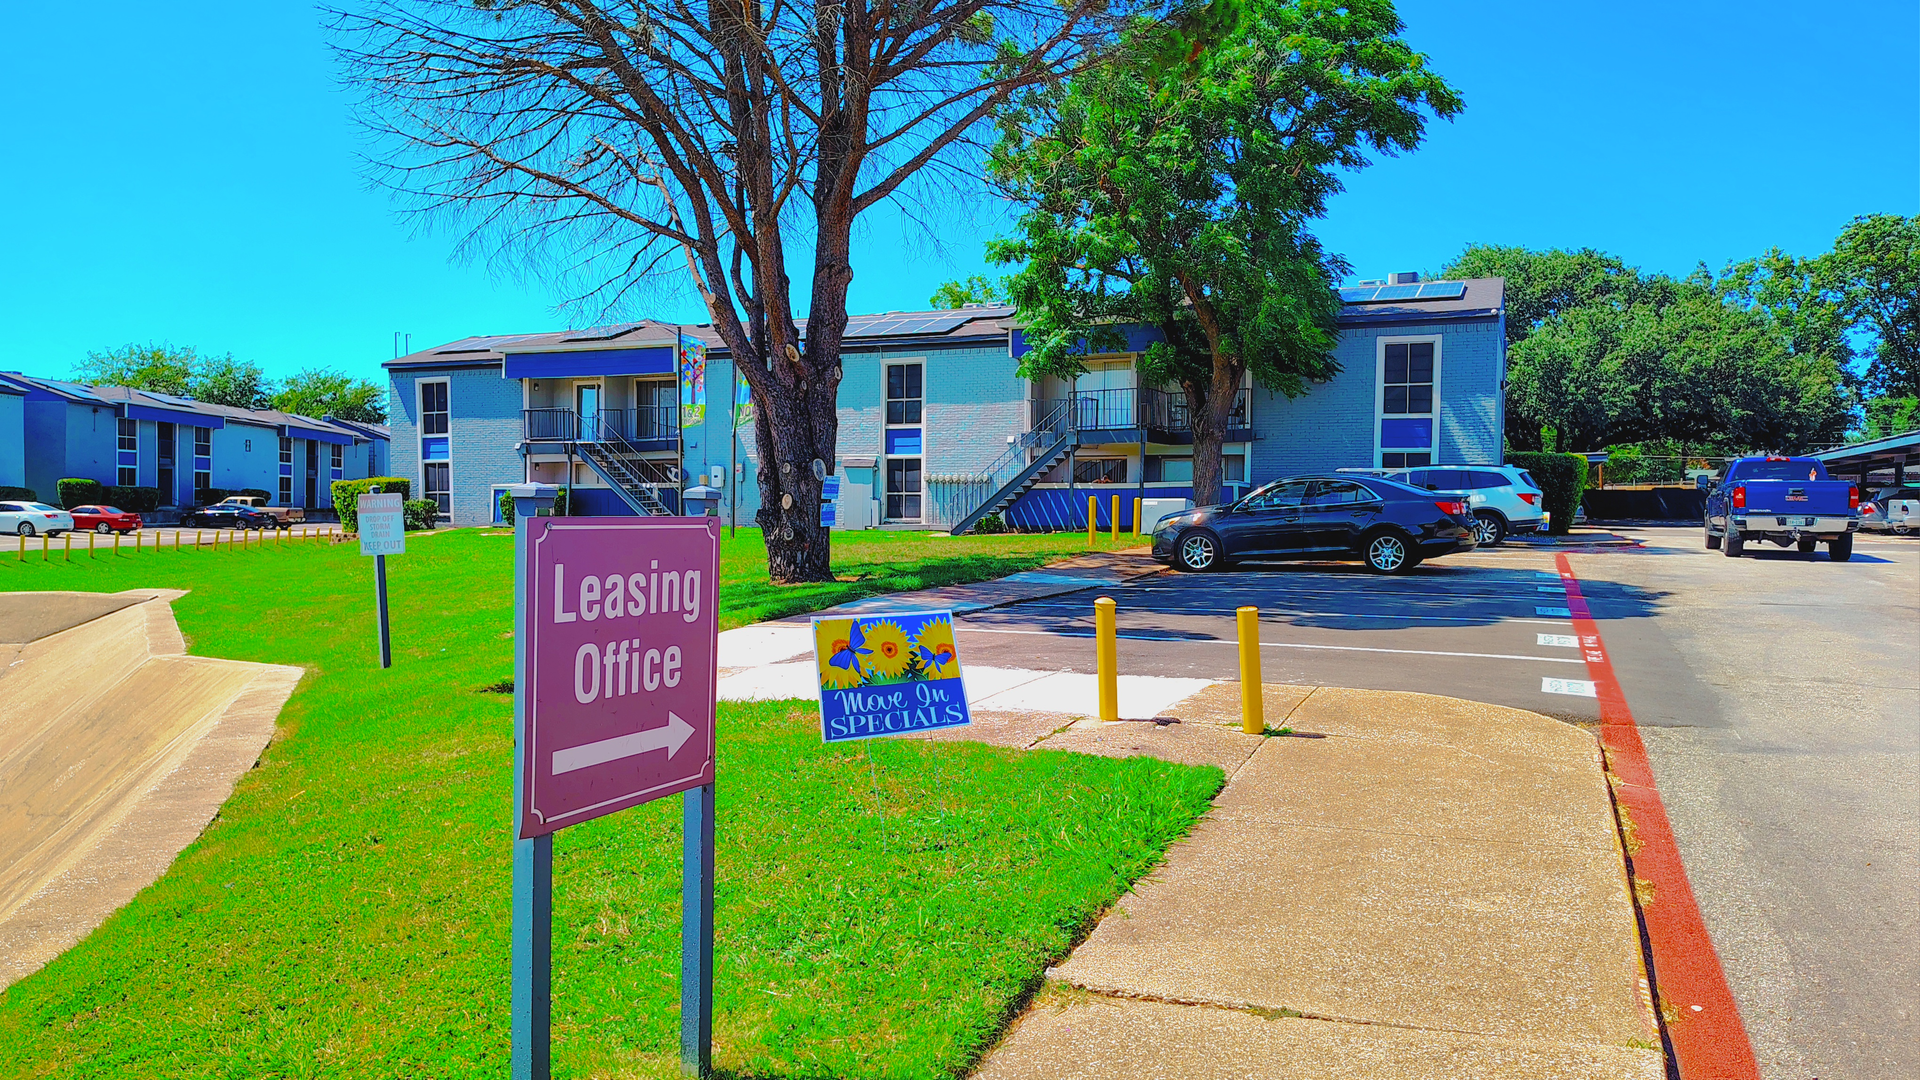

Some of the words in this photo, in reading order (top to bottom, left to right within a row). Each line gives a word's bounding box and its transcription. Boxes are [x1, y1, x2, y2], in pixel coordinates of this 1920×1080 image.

[360, 499, 400, 509] WARNING
[370, 523, 390, 531] STORM
[364, 541, 381, 551] KEEP
[384, 540, 401, 549] OUT
[553, 559, 702, 624] Leasing
[574, 637, 683, 705] Office
[834, 690, 908, 715] Move
[915, 682, 950, 708] In
[830, 701, 964, 739] SPECIALS
